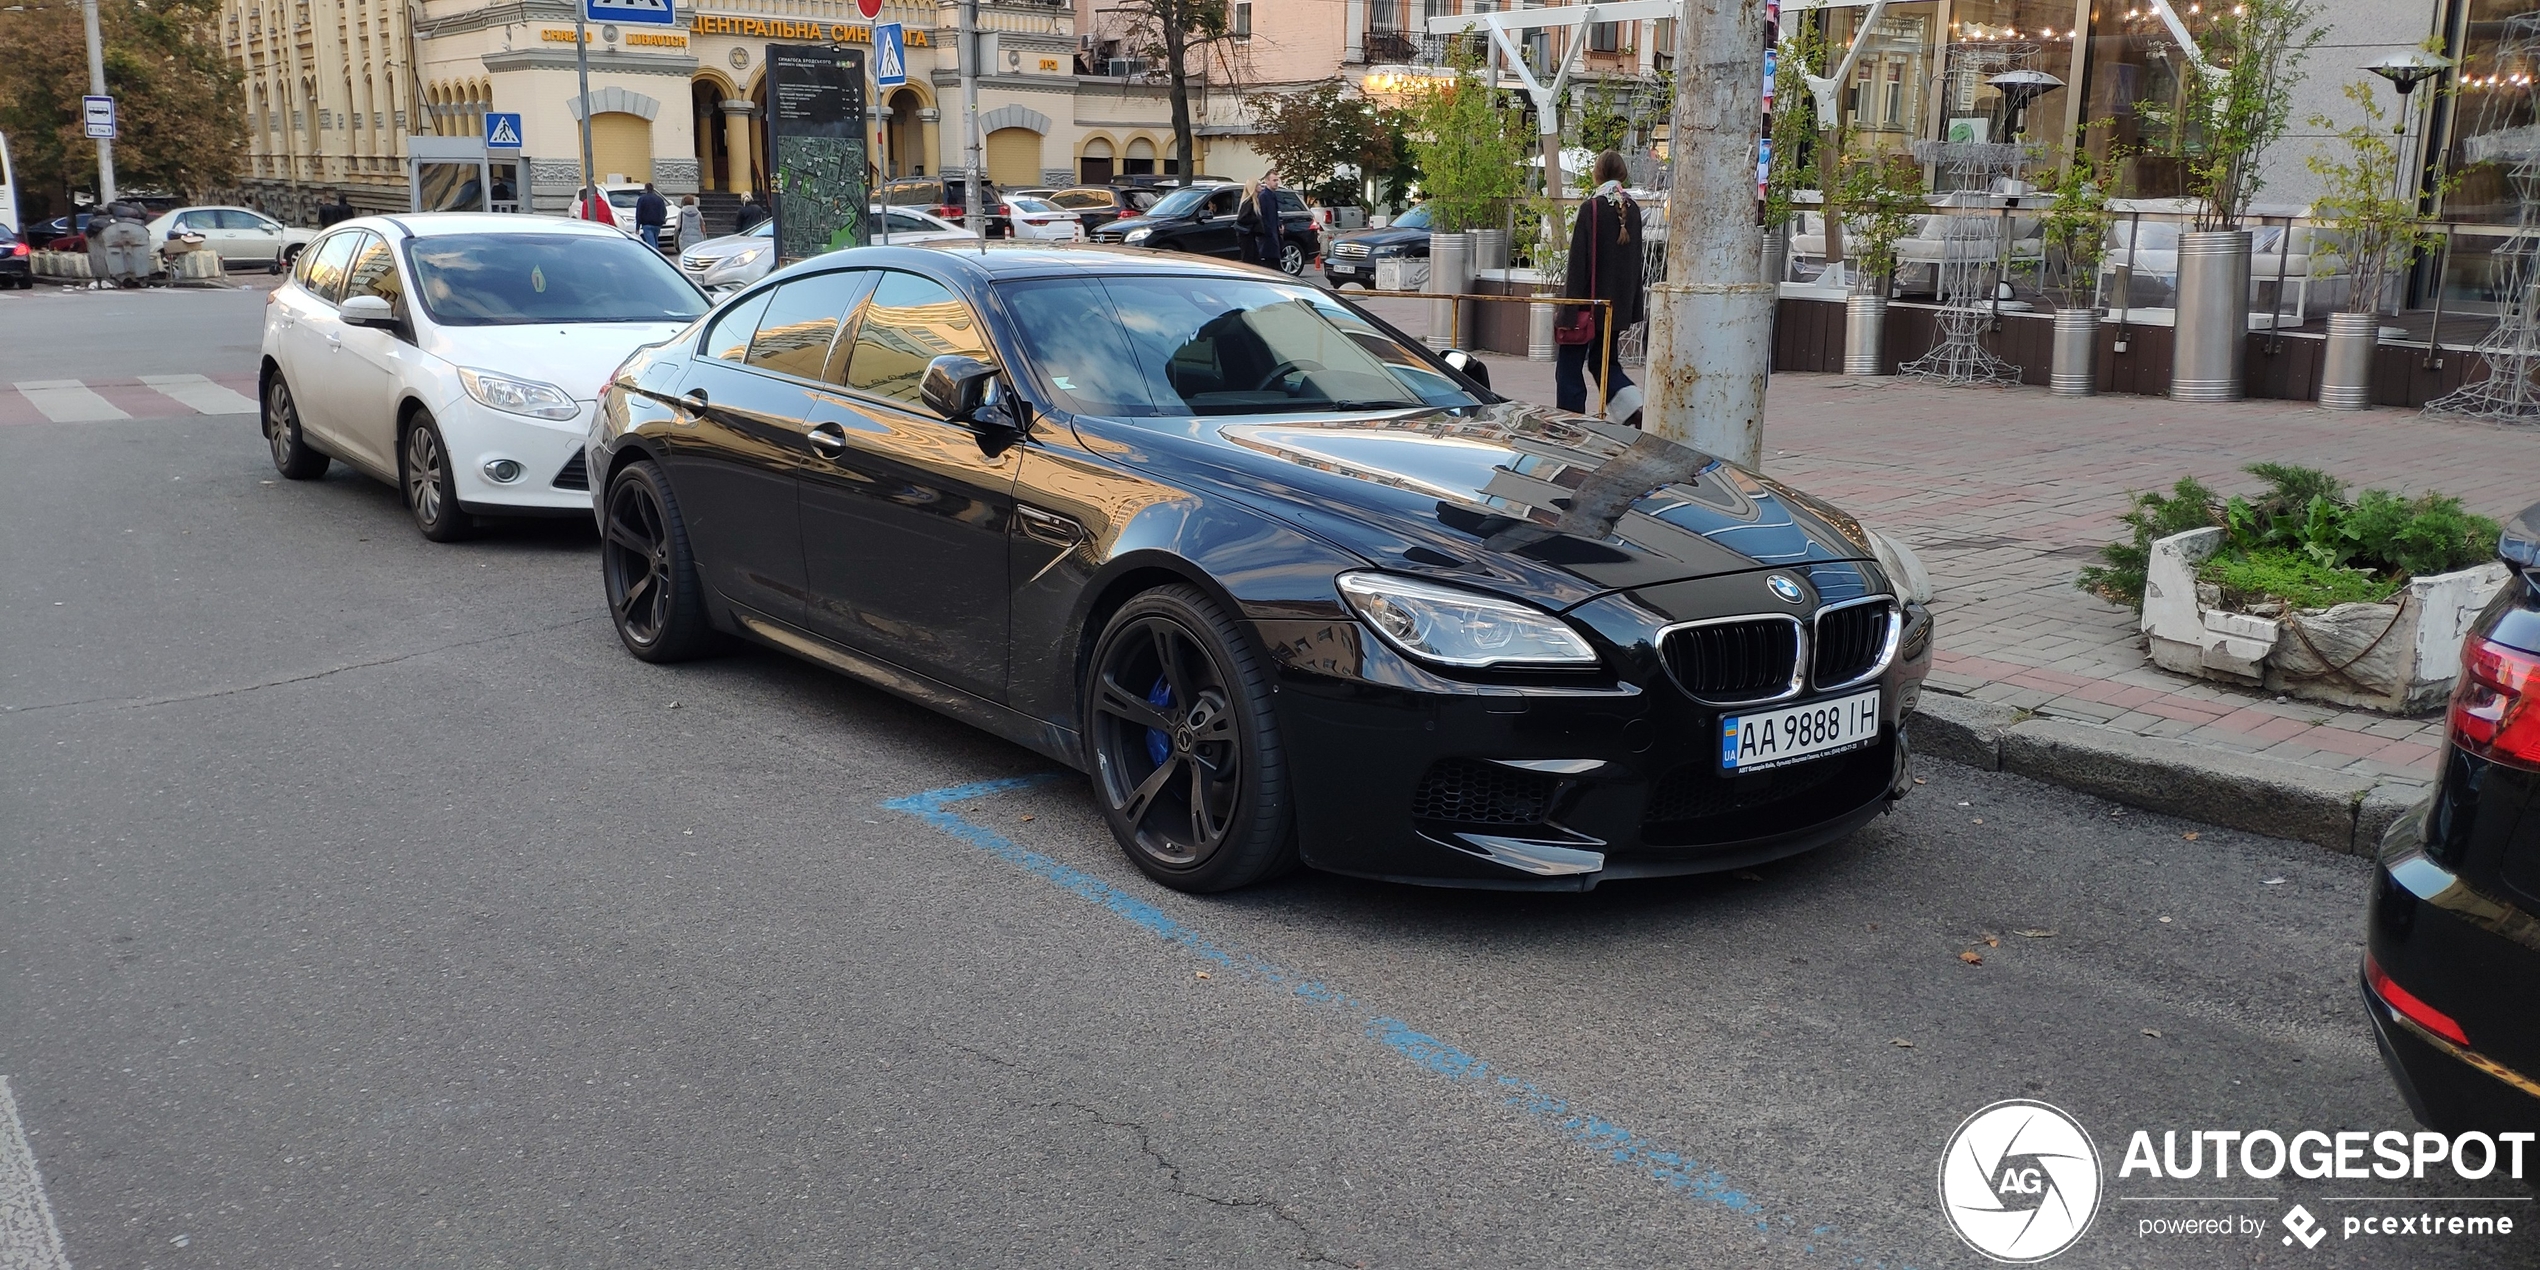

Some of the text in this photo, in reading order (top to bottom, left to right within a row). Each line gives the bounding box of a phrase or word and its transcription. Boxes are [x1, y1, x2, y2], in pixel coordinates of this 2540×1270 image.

[541, 29, 688, 47] CHABD LUBAVICH
[690, 14, 823, 40] ЦЕНТРАЛЬНА
[1739, 718, 1777, 760] AA
[1784, 706, 1840, 751] 9888
[1724, 750, 1736, 762] UA
